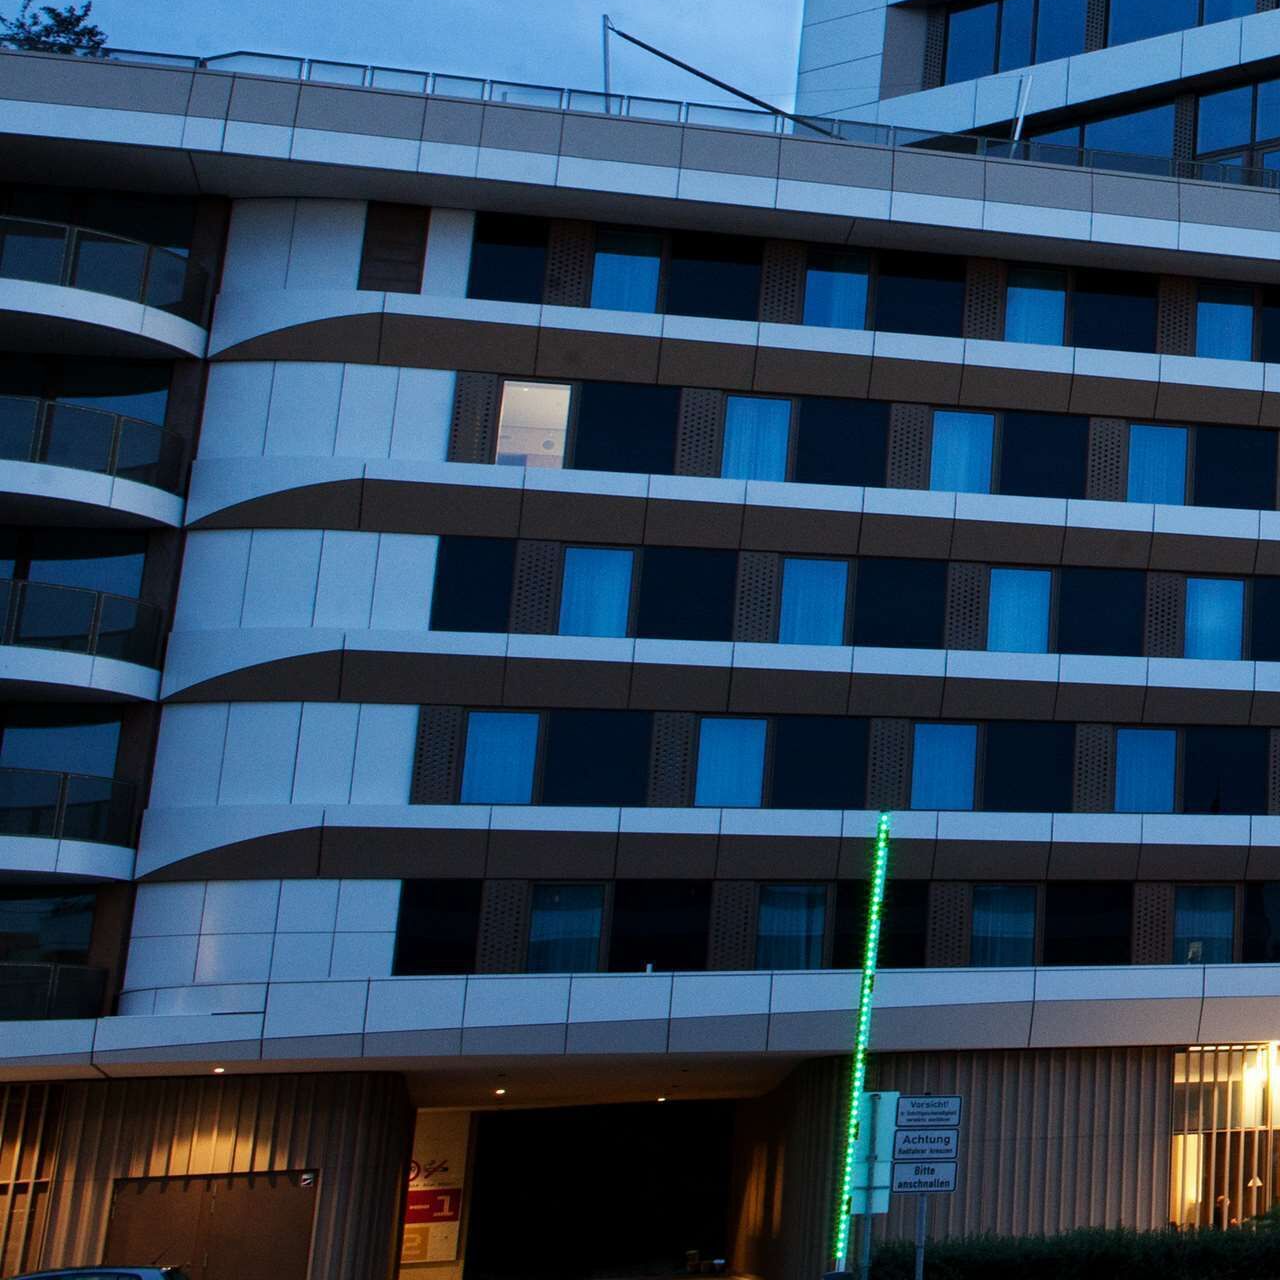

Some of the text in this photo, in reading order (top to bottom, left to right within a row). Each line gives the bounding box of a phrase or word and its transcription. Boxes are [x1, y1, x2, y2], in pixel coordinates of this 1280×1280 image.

[902, 1135, 951, 1146] Achtung
[914, 1165, 936, 1175] Bitte
[897, 1178, 951, 1189] anschnallen
